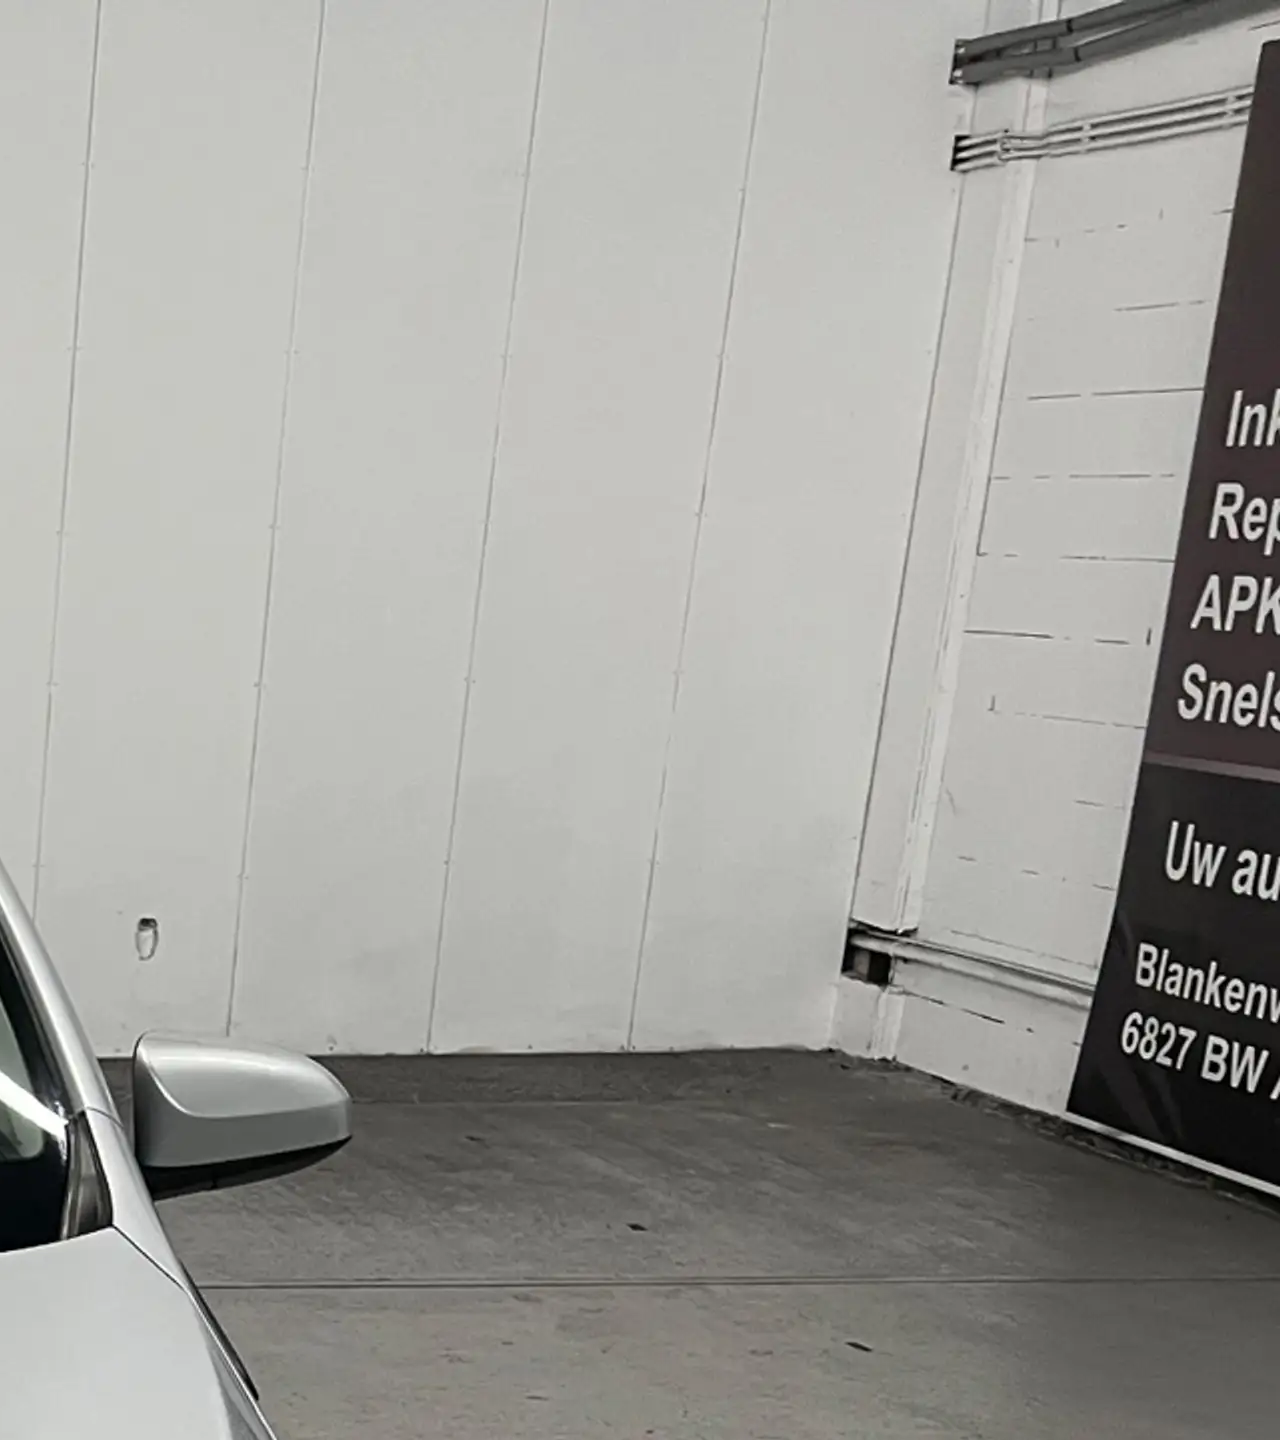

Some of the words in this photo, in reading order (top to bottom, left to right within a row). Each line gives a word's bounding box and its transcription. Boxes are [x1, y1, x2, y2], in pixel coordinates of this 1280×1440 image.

[1190, 573, 1280, 636] APK
[1165, 820, 1228, 888] Uw
[1231, 849, 1280, 902] au
[1121, 1011, 1197, 1071] 6827
[1200, 1034, 1269, 1093] BW
